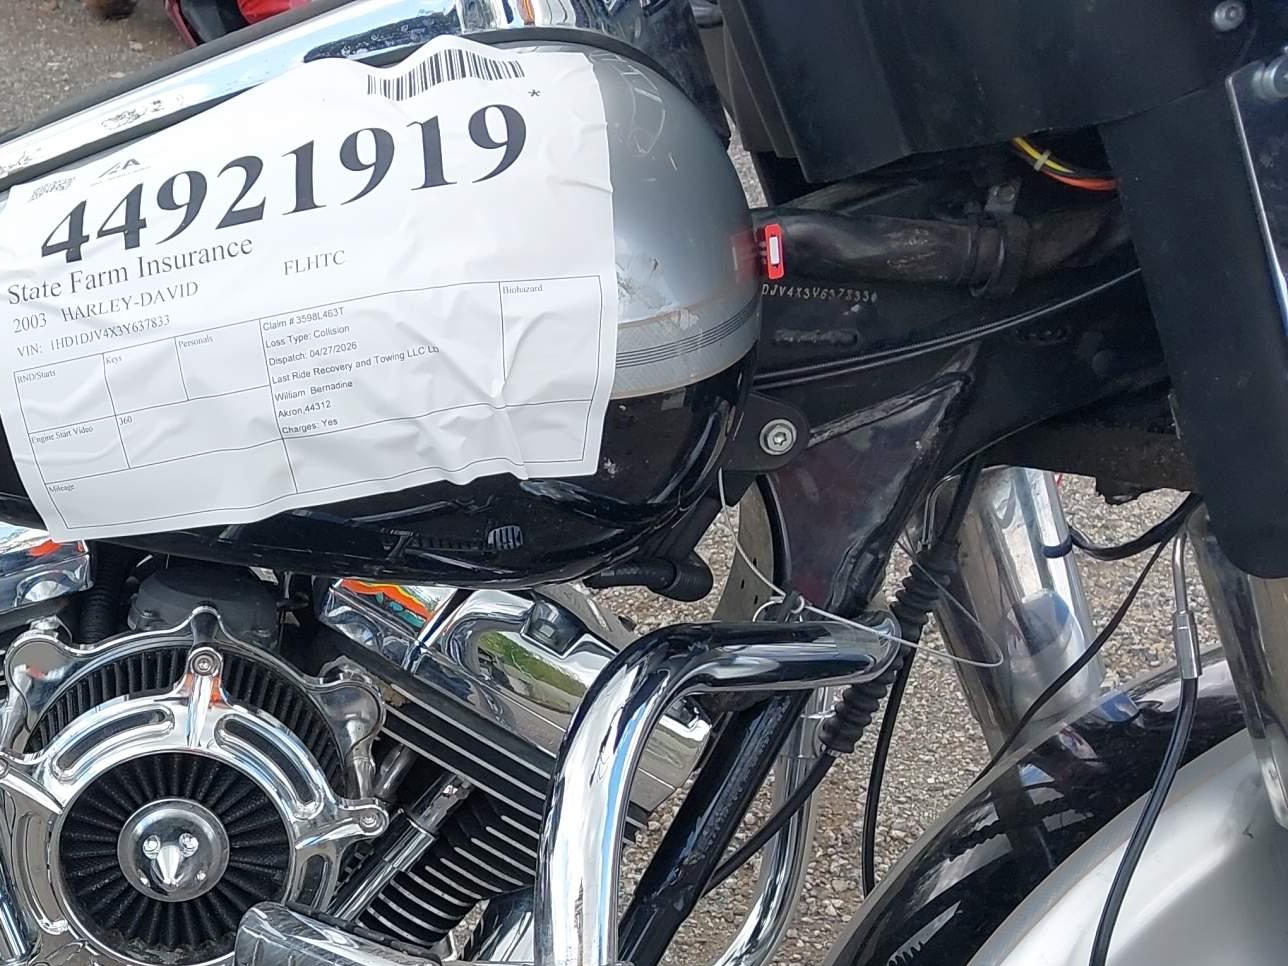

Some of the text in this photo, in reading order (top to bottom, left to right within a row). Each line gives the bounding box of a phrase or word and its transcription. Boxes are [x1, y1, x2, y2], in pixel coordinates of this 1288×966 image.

[40, 103, 527, 264] 44921919
[7, 237, 253, 304] State Farm Insurance
[283, 250, 345, 276] FLHTC
[503, 284, 543, 295] Biohazard
[13, 281, 199, 333] 2003 HARLEY-DAVID
[263, 319, 286, 331] Claim
[178, 335, 213, 349] Personals
[266, 339, 286, 349] Loss
[313, 325, 350, 339] Collision
[17, 343, 42, 357] VIN:
[268, 342, 358, 367] Dispatch: 04/27/2026
[105, 355, 122, 366] Keys
[272, 374, 290, 385] Last
[292, 370, 311, 380] Ride
[313, 362, 353, 377] Recovery
[355, 358, 372, 369] and
[373, 350, 405, 365] Towing
[407, 346, 425, 358] LLC
[274, 380, 353, 402] William Bernadine
[118, 415, 133, 426] 360
[281, 418, 338, 434] Charges: Yes
[31, 425, 94, 444] Engine Start Video
[49, 483, 75, 494] Mileage
